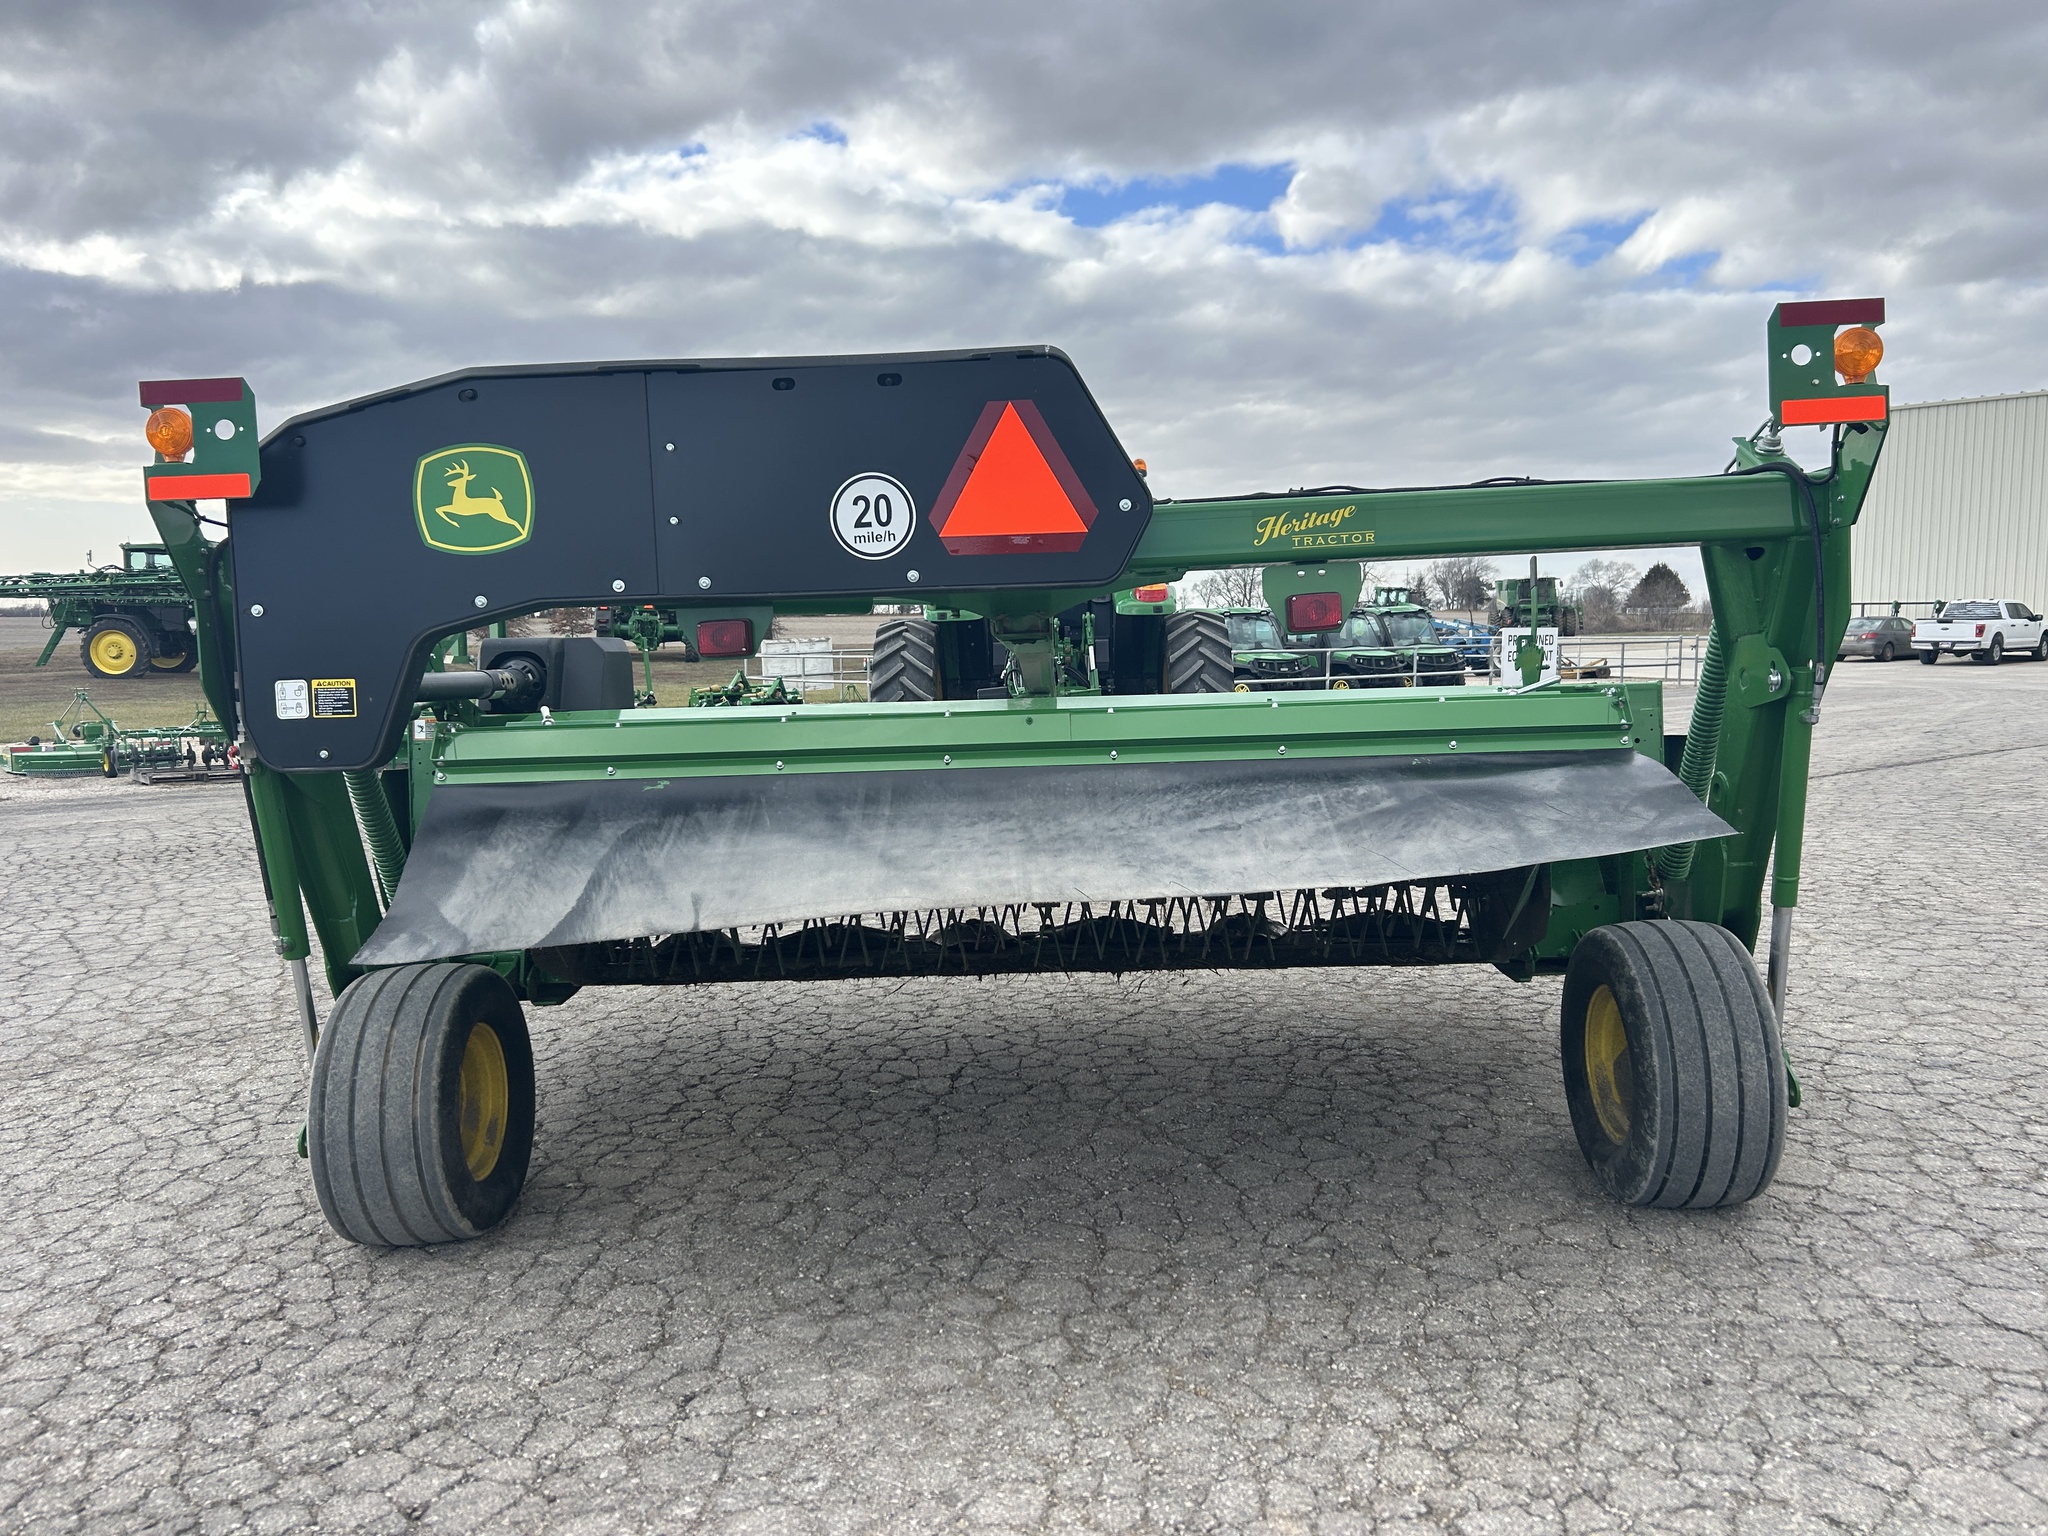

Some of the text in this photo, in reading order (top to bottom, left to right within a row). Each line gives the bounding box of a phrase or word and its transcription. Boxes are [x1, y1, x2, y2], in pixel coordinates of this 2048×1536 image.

[852, 493, 893, 529] 20
[853, 530, 897, 544] mile/h
[1253, 505, 1358, 546] Heritage
[1292, 532, 1375, 547] TRACTOR
